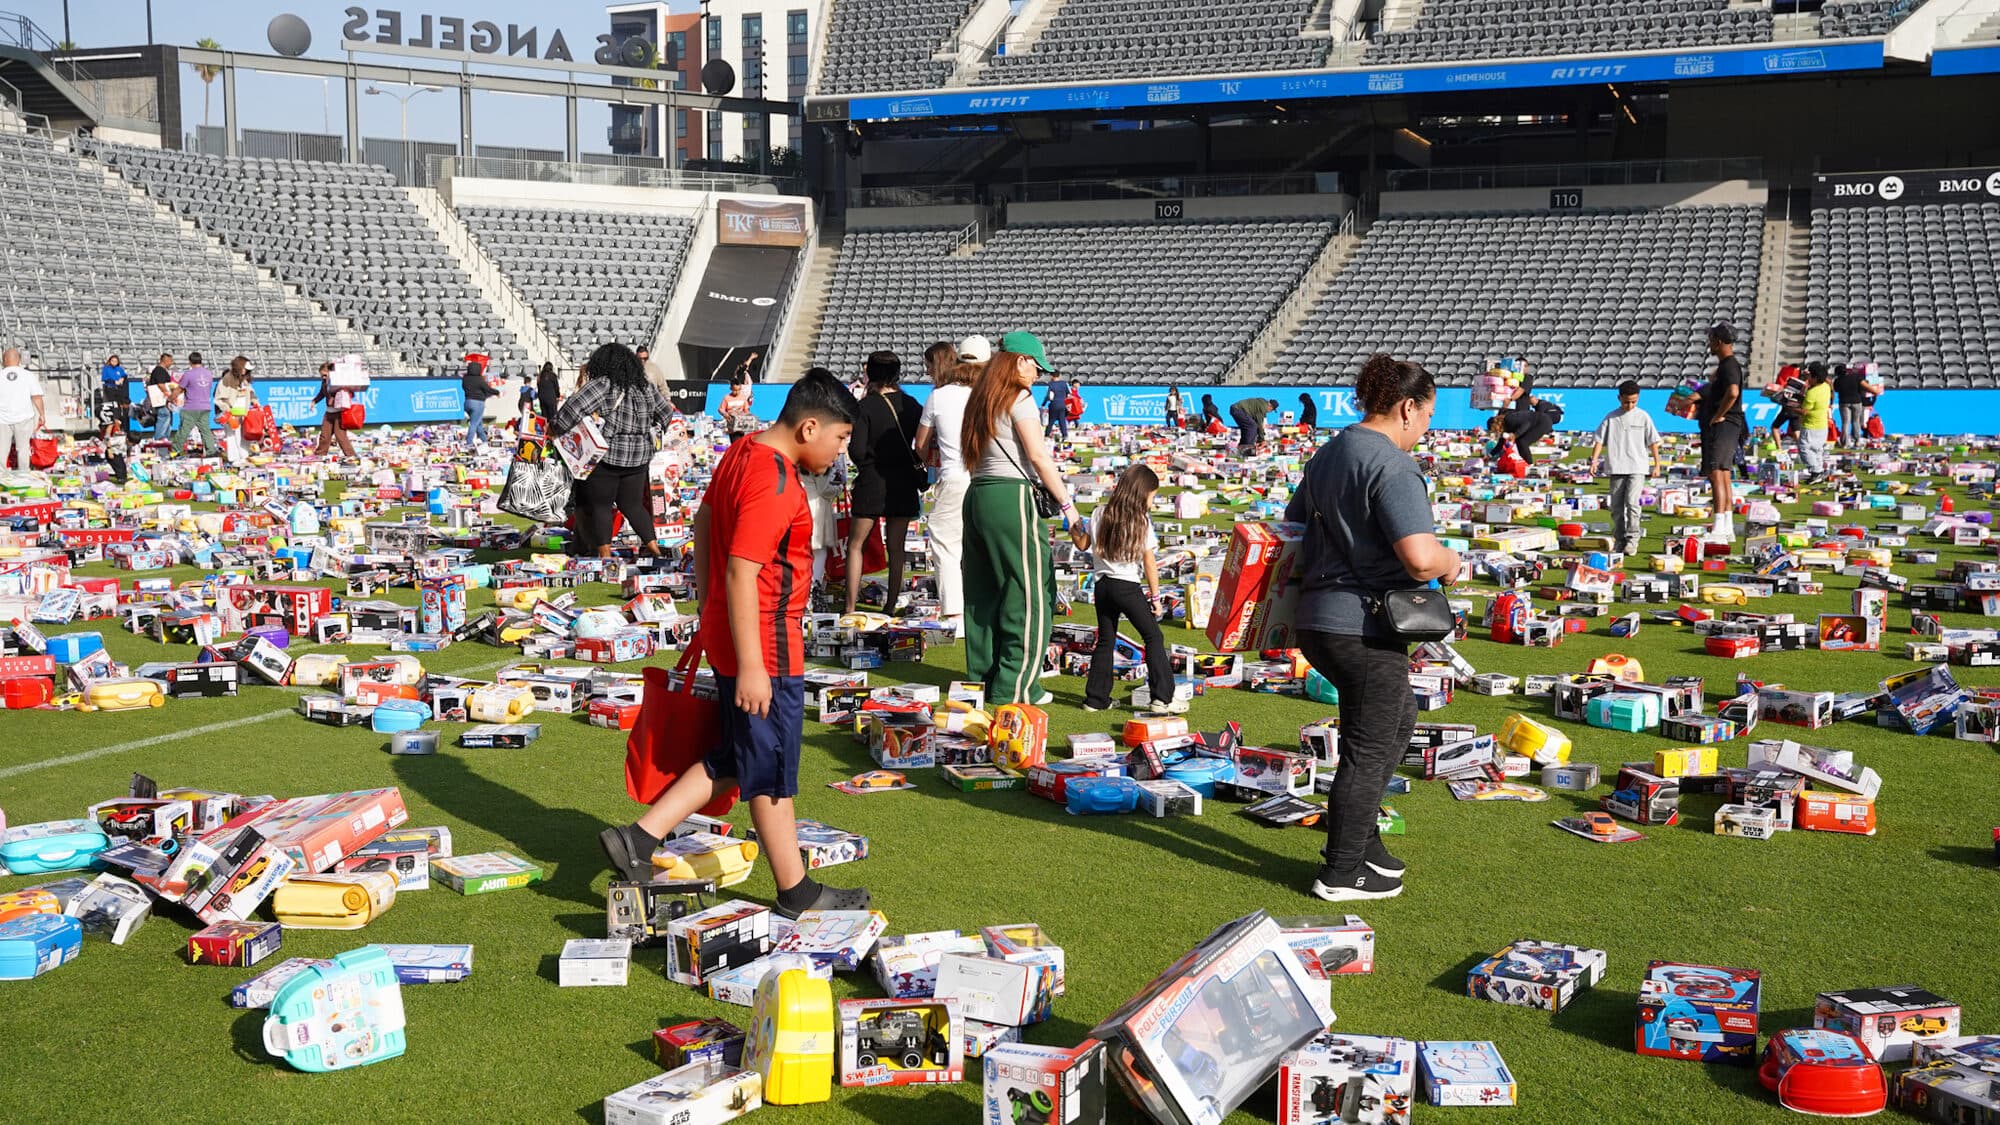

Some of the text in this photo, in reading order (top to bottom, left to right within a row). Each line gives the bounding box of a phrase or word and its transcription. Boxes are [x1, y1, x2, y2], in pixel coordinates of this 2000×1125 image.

[1675, 55, 1713, 63] REALITY
[1551, 64, 1628, 80] RITFIT
[1674, 64, 1714, 75] GAMES
[1454, 72, 1507, 83] MEMEHOUSE
[1368, 81, 1404, 91] GAMES
[969, 96, 1030, 109] RITFIT
[1147, 92, 1181, 103] GAMES
[1834, 183, 1874, 196] BMO
[1939, 179, 1982, 192] BMO
[1554, 193, 1579, 207] 110
[1157, 204, 1180, 218] 109
[708, 291, 748, 303] BMO
[269, 386, 316, 396] REALITY
[1320, 391, 1356, 417] TK
[1129, 406, 1149, 416] TOY
[974, 778, 1017, 791] SUBWAY
[1557, 774, 1571, 785] DC
[477, 873, 532, 892] SUBWAY
[1159, 985, 1194, 1029] PURSUIT
[1137, 1001, 1168, 1038] POLICE
[865, 1074, 891, 1084] TRUCK
[1291, 1072, 1301, 1123] TRANSFORMERS
